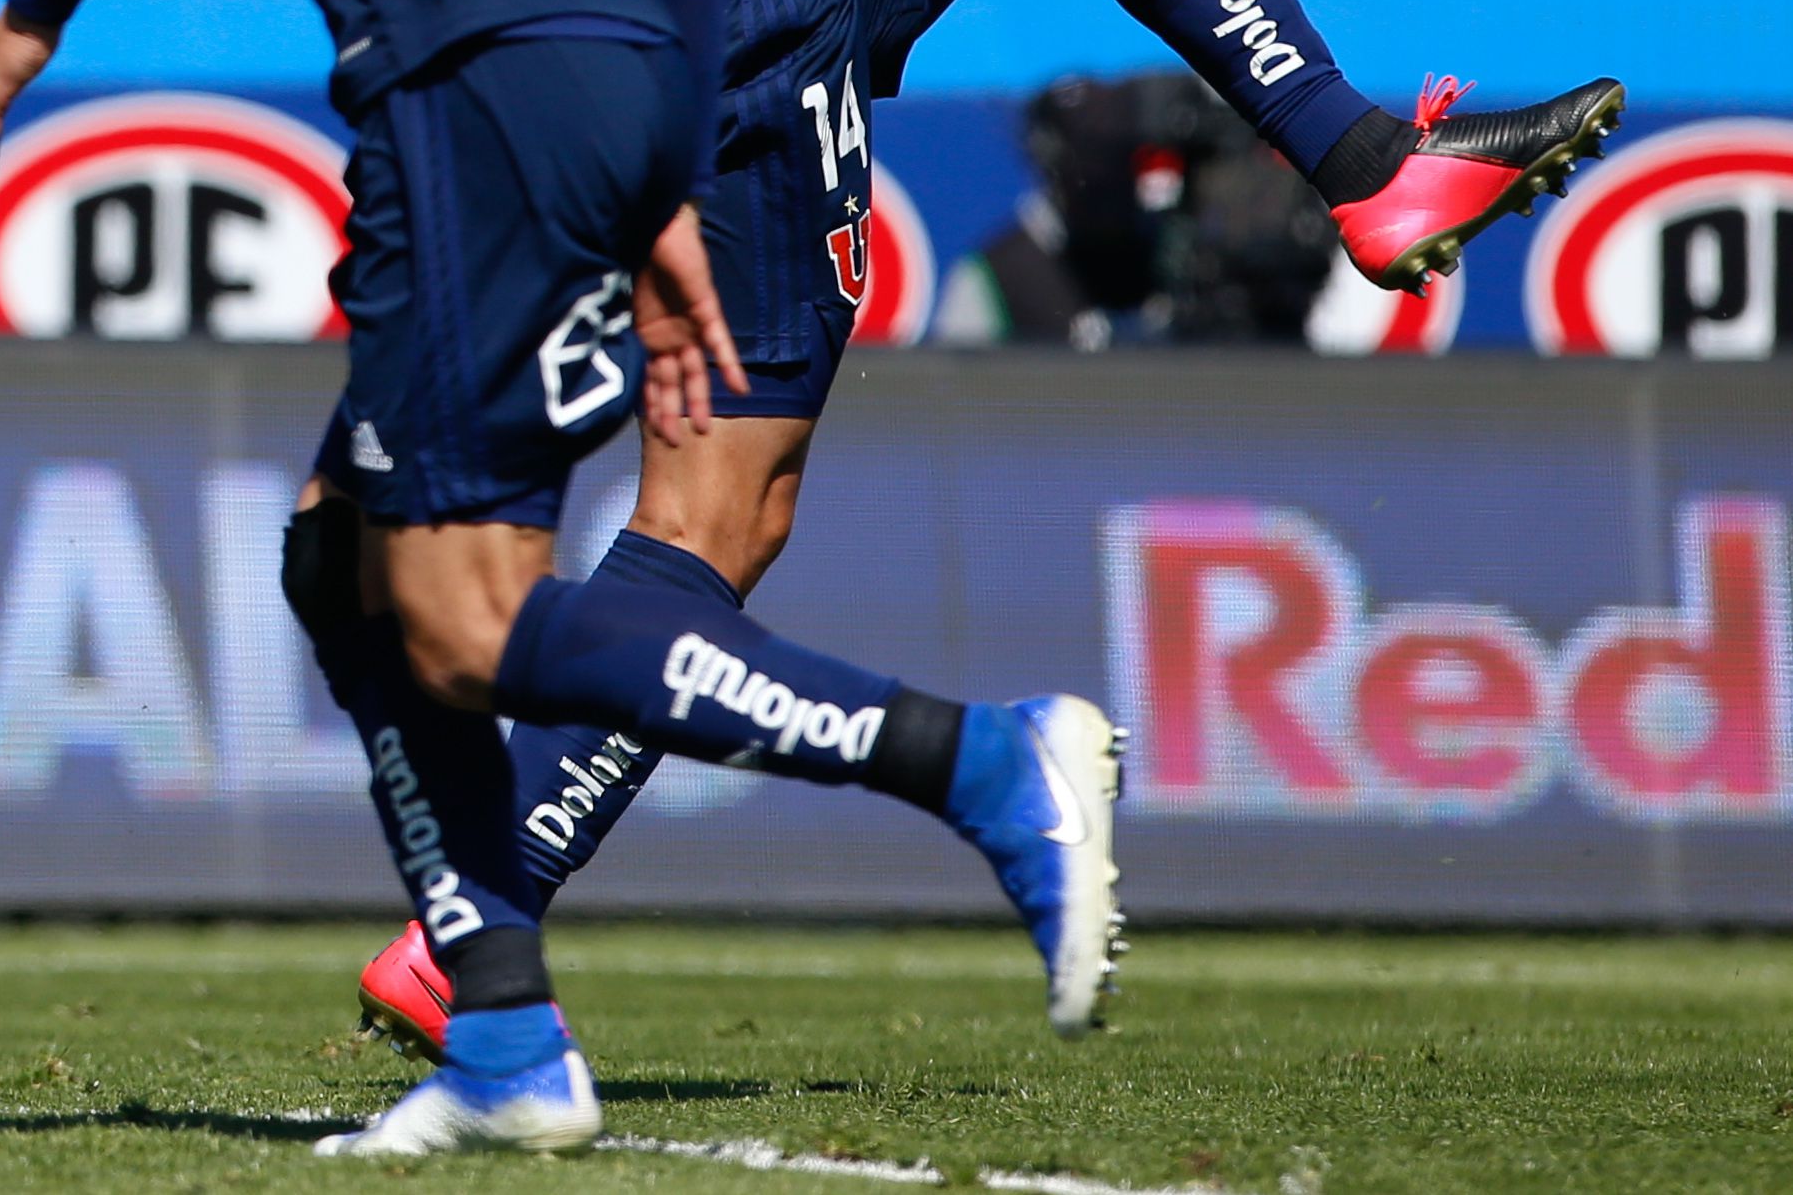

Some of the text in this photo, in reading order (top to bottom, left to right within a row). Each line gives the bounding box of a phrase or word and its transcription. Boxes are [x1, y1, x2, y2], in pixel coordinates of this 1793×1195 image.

[800, 58, 868, 193] 14
[1659, 206, 1793, 353] P
[660, 630, 888, 764] Dolorub
[1103, 497, 1793, 819] Red
